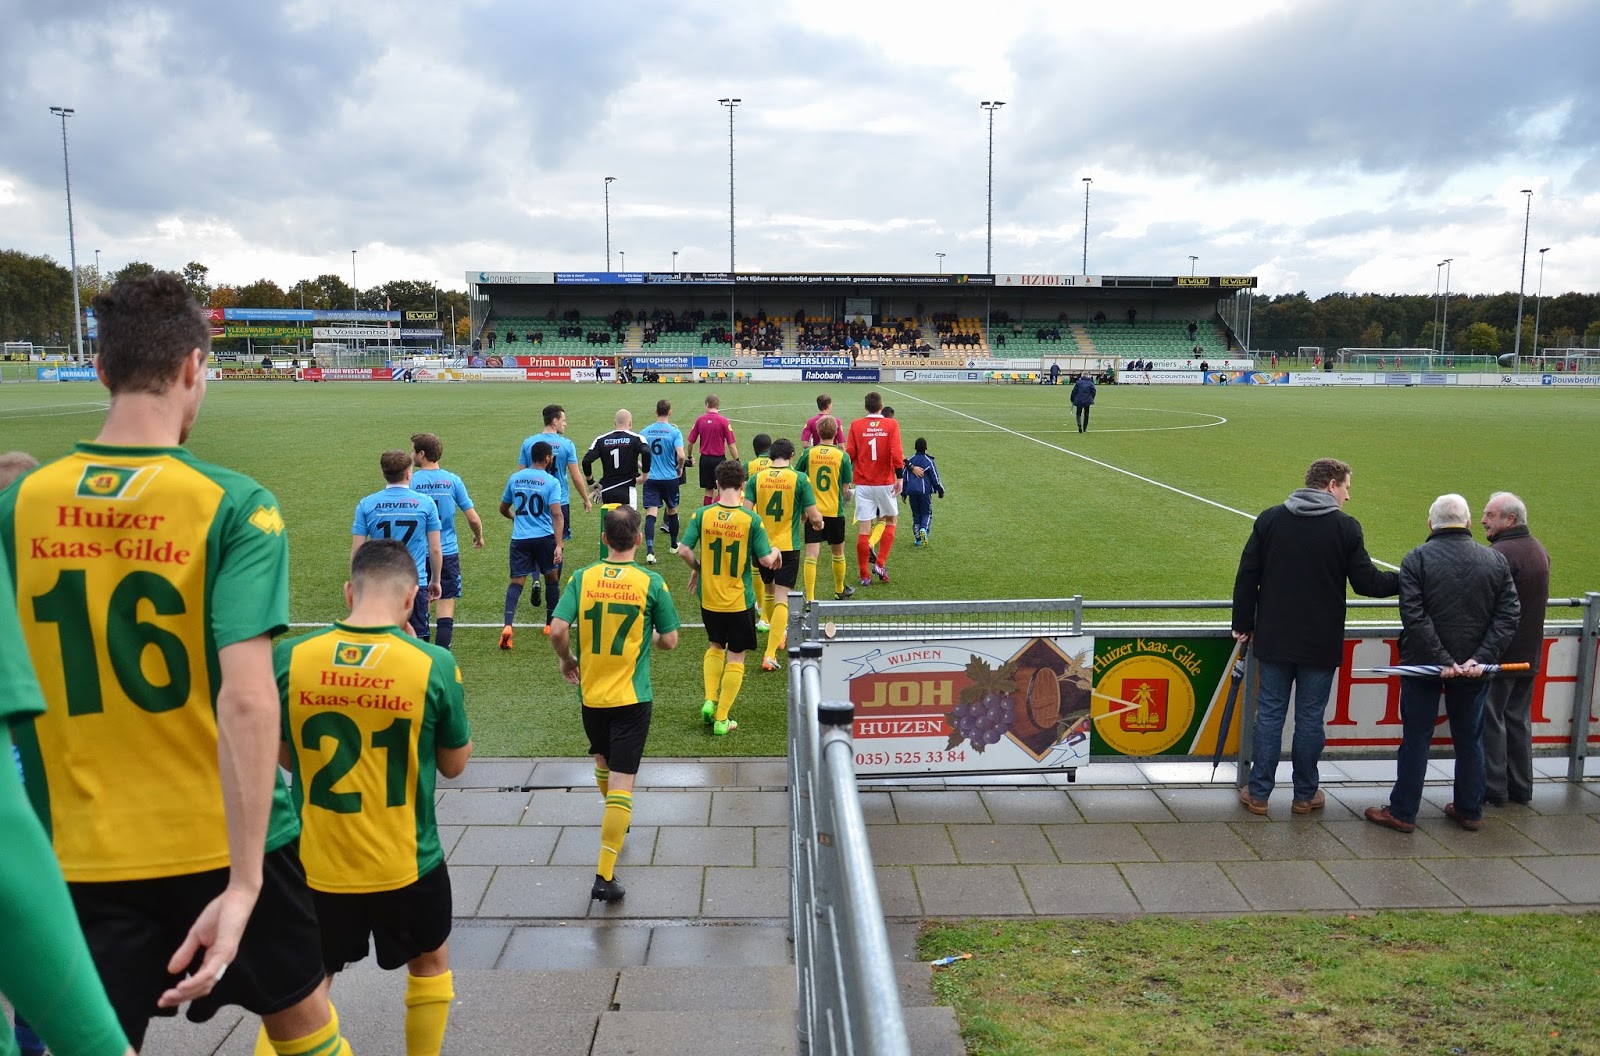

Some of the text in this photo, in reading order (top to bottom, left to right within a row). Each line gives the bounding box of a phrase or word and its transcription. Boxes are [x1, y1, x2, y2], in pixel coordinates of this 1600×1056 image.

[1021, 276, 1075, 286] HZ101.nl
[530, 357, 556, 367] Prima
[589, 357, 609, 367] kas
[636, 357, 688, 365] europeesche
[805, 371, 843, 380] Rabobank
[1553, 376, 1600, 384] Bouwbedrijf
[651, 438, 662, 456] 6
[868, 438, 877, 461] 1
[610, 448, 620, 469] 1
[514, 479, 545, 487] AIRVIEW
[816, 465, 832, 492] 6
[514, 492, 544, 517] 20
[766, 491, 784, 522] 4
[56, 504, 166, 532] Huizer
[712, 522, 738, 531] Huizer
[376, 520, 418, 544] 17
[705, 528, 745, 539] Kaas-Gilde
[30, 536, 191, 566] Kaas-Gilde
[709, 537, 740, 579] 11
[597, 580, 632, 590] Huizer
[586, 590, 641, 602] Kaas-Gilde
[584, 601, 641, 656] 17
[32, 569, 192, 717] 16
[887, 650, 942, 666] WIJNEN
[1093, 637, 1202, 676] Huizer Kaas-Gilde
[320, 670, 394, 690] Huizer
[298, 691, 413, 713] Kaas-Gilde
[861, 680, 954, 708] JOH
[859, 720, 943, 736] HUIZEN
[301, 711, 412, 814] 21
[855, 750, 966, 766] 035) 525 33 84
